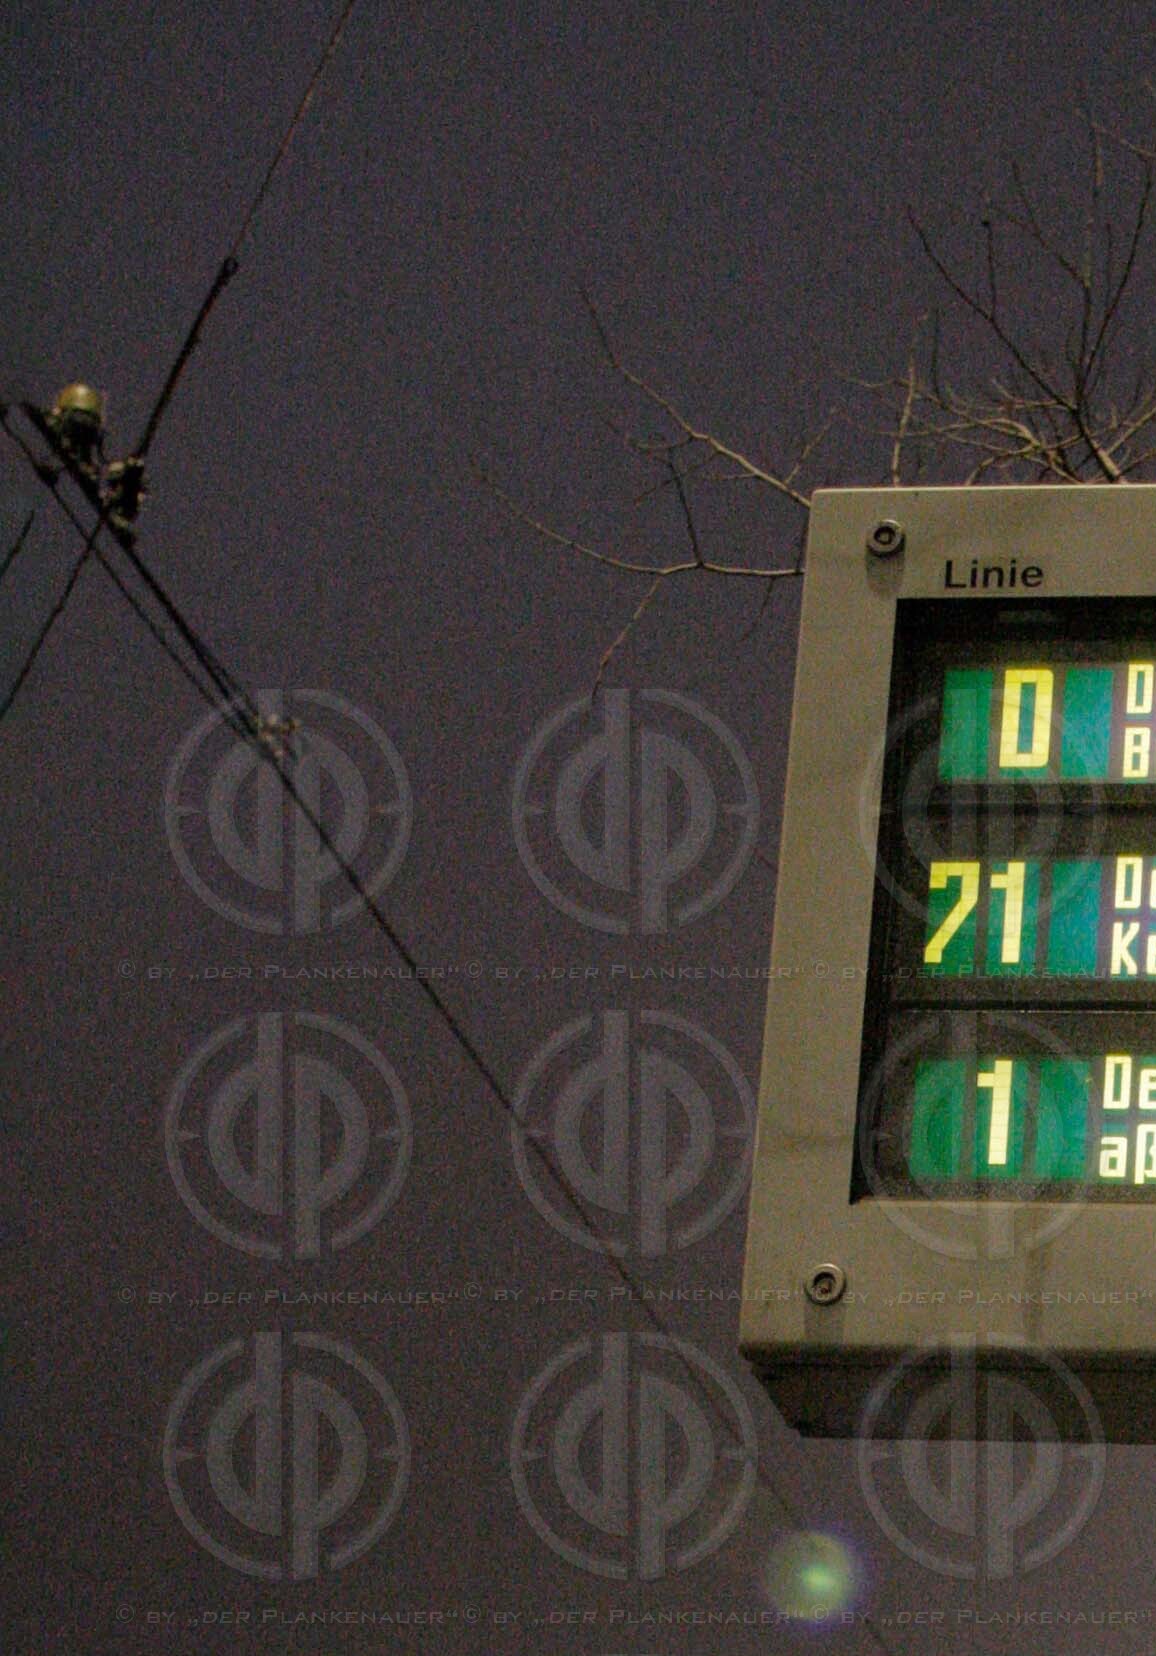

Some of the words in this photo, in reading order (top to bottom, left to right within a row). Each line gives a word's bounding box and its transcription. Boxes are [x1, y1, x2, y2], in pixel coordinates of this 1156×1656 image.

[944, 560, 1044, 588] Linie
[999, 669, 1054, 768] D
[923, 861, 1026, 963] 71
[976, 1060, 1013, 1165] 1
